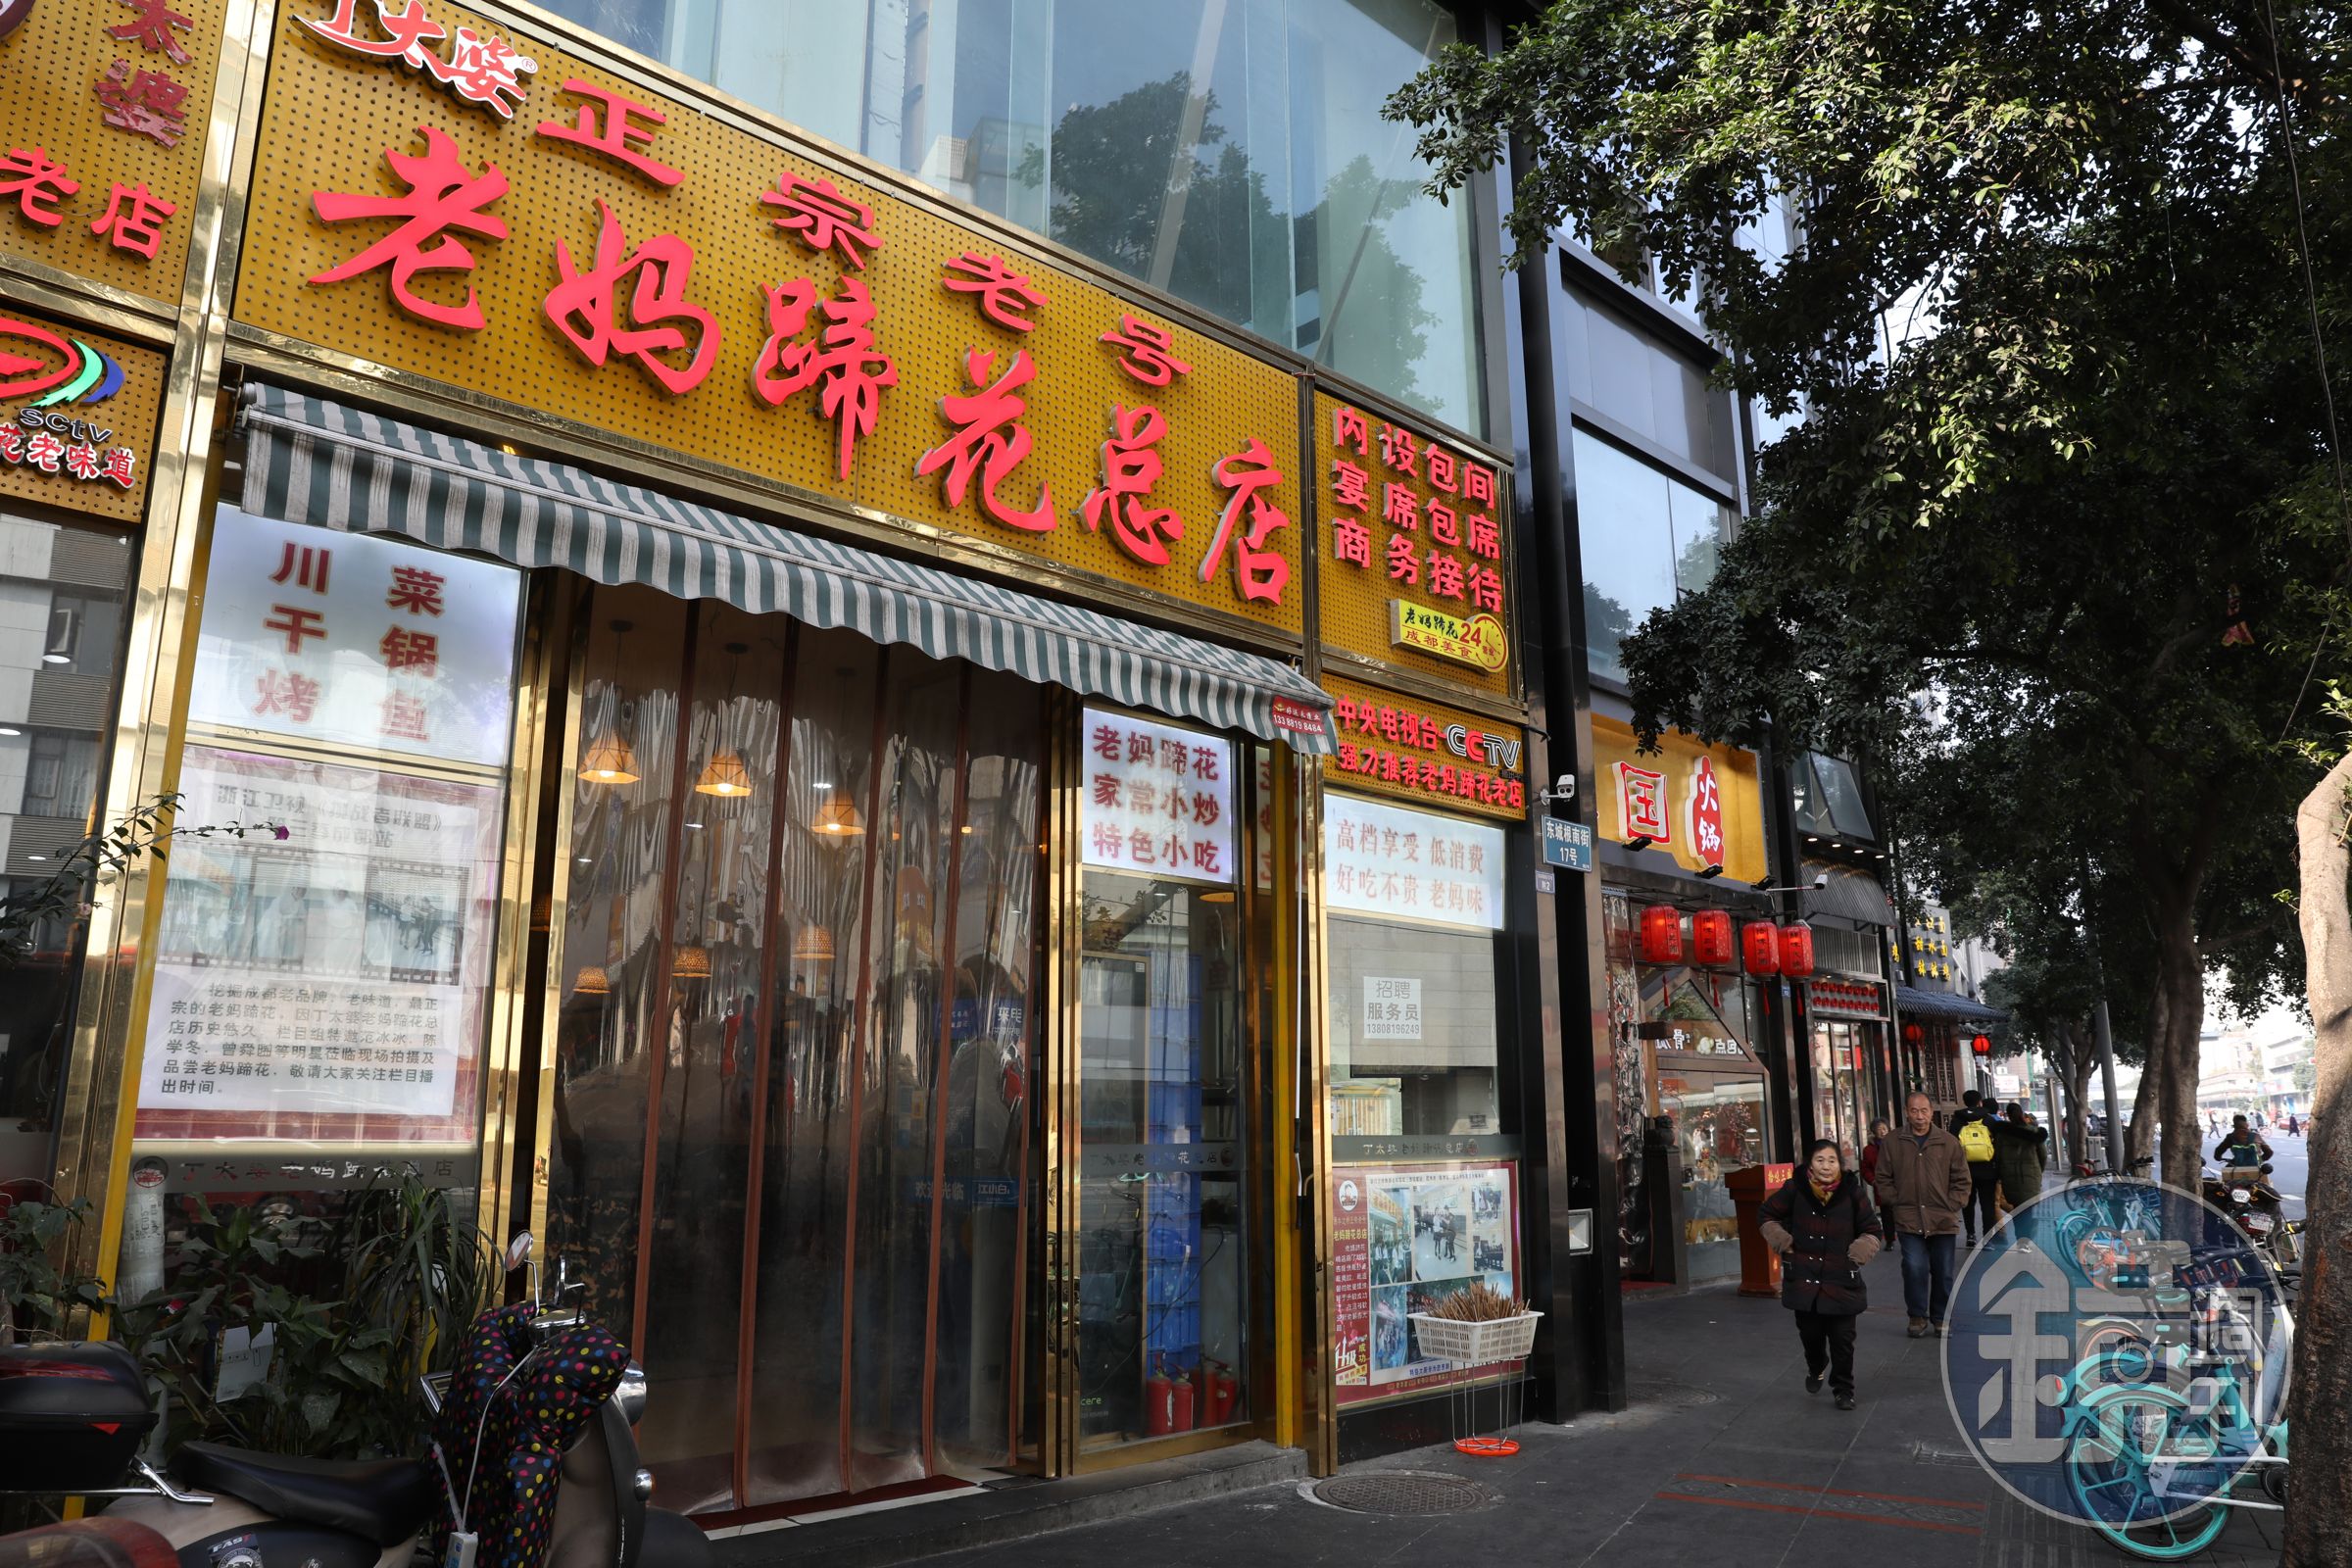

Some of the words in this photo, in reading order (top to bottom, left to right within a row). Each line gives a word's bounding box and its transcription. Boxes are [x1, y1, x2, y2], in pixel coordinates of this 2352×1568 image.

[306, 125, 1291, 608] 老妈蹄花总店
[1334, 407, 1495, 510] 内设包间
[1332, 461, 1499, 561] 宴席包席
[1333, 517, 1502, 612] 商务接待
[1405, 630, 1473, 659] 成都美食
[1093, 725, 1219, 781] 老妈蹄花
[1093, 773, 1220, 826] 家常小炒
[1093, 821, 1220, 874] 特色小吃
[1367, 1003, 1419, 1021] 服务员
[1375, 980, 1411, 999] 招聘
